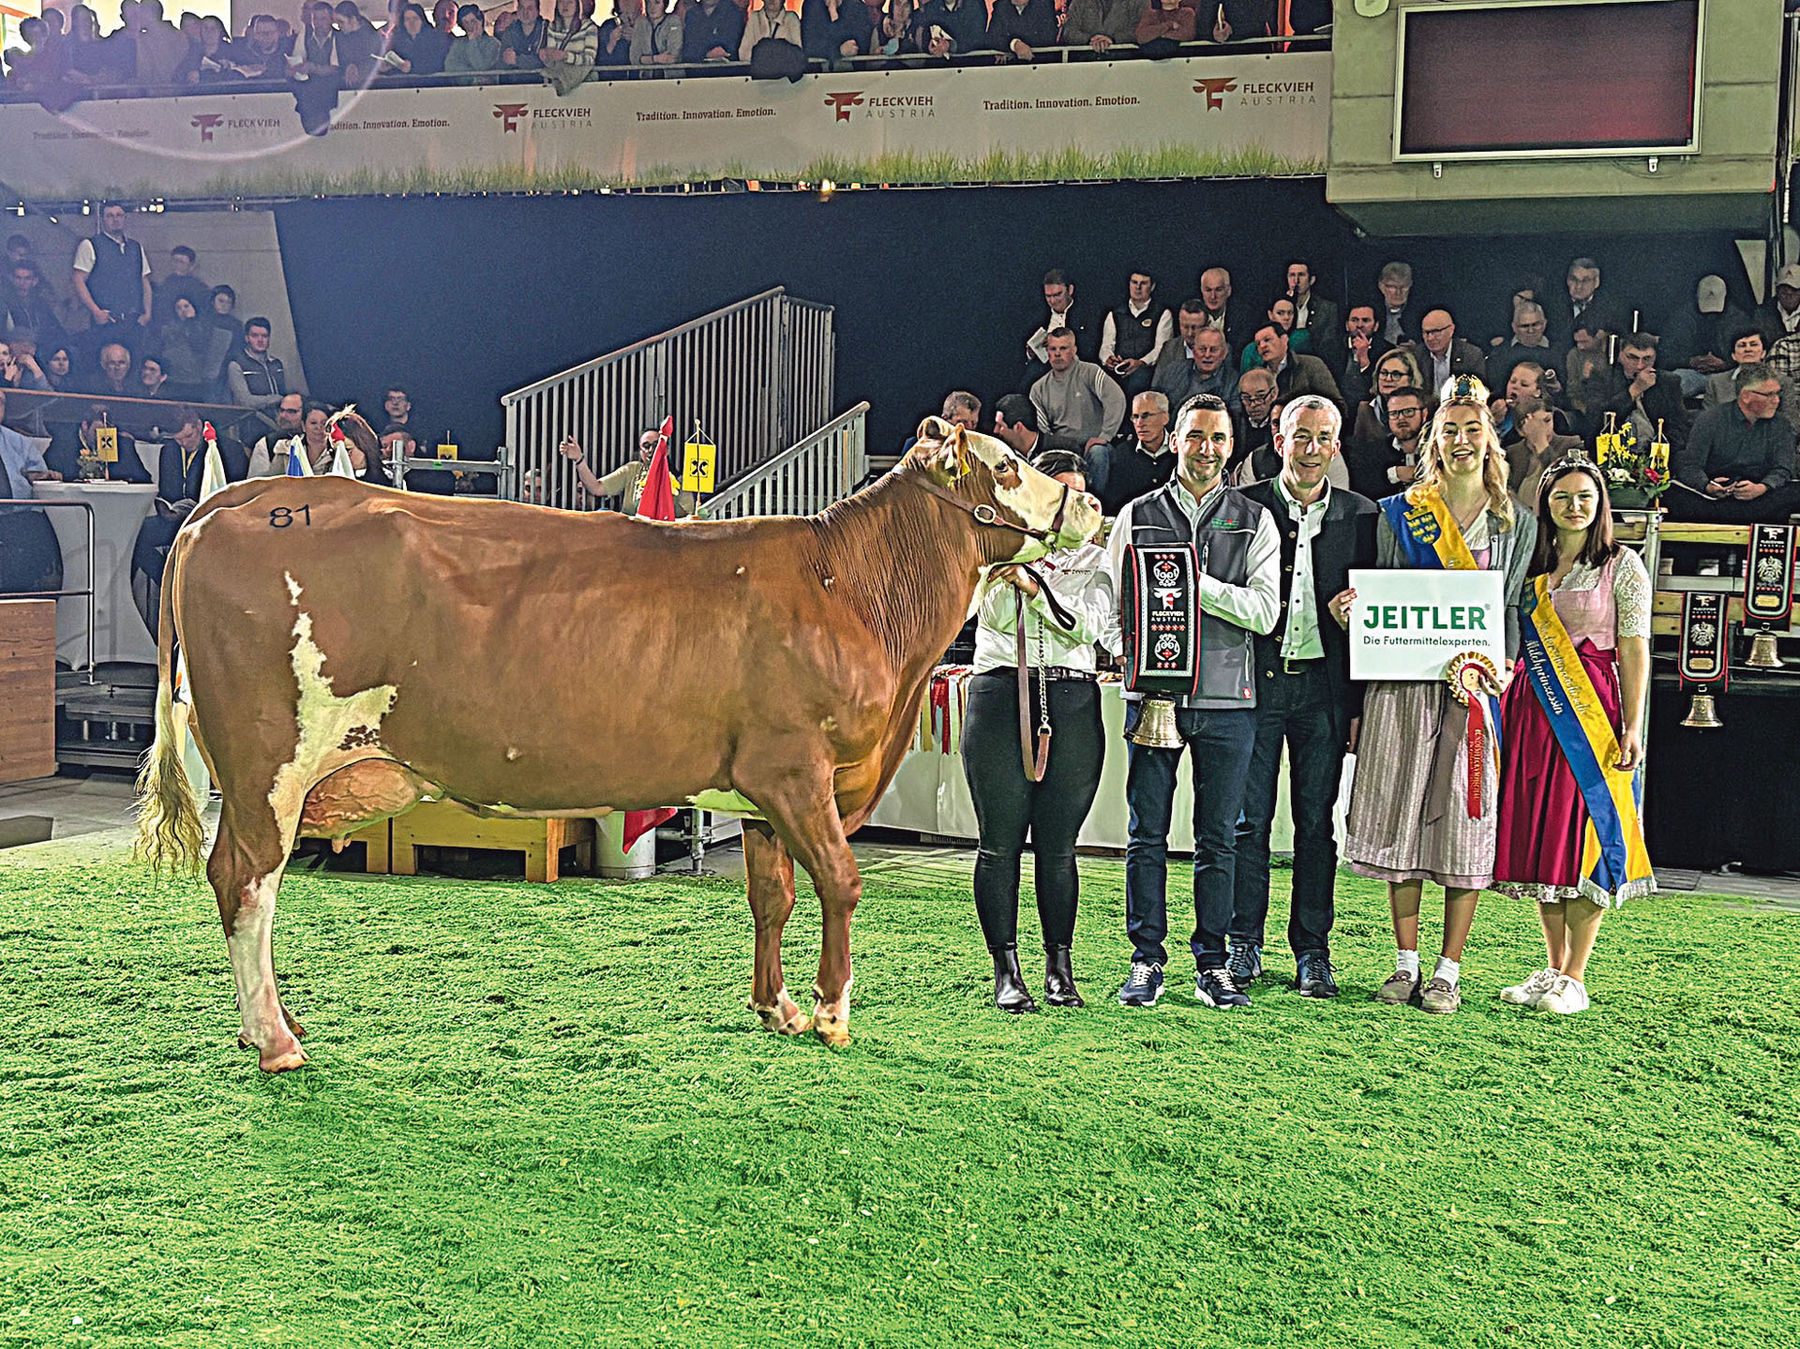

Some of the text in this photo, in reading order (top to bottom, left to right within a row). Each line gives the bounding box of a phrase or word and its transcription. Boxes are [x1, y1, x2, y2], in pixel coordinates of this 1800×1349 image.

[1243, 82, 1314, 94] FLECKVIEH
[869, 96, 934, 107] FLECKVIEH
[983, 95, 1141, 111] Tradition. Innovation. Emotion.
[1240, 95, 1316, 106] AUSTRIA
[533, 107, 591, 118] FLECKVIEH
[636, 107, 776, 121] Tradition. Innovation. Emotion.
[865, 109, 935, 119] AUSTRIA
[228, 119, 280, 129] FLECKVIEH
[363, 120, 409, 130] Innovation.
[412, 118, 450, 128] Emotion.
[532, 119, 592, 130] AUSTRIA
[269, 504, 310, 528] 81
[1363, 635, 1491, 648] Die Futtermittelexperten.
[1524, 638, 1564, 716] Milchprinzessin
